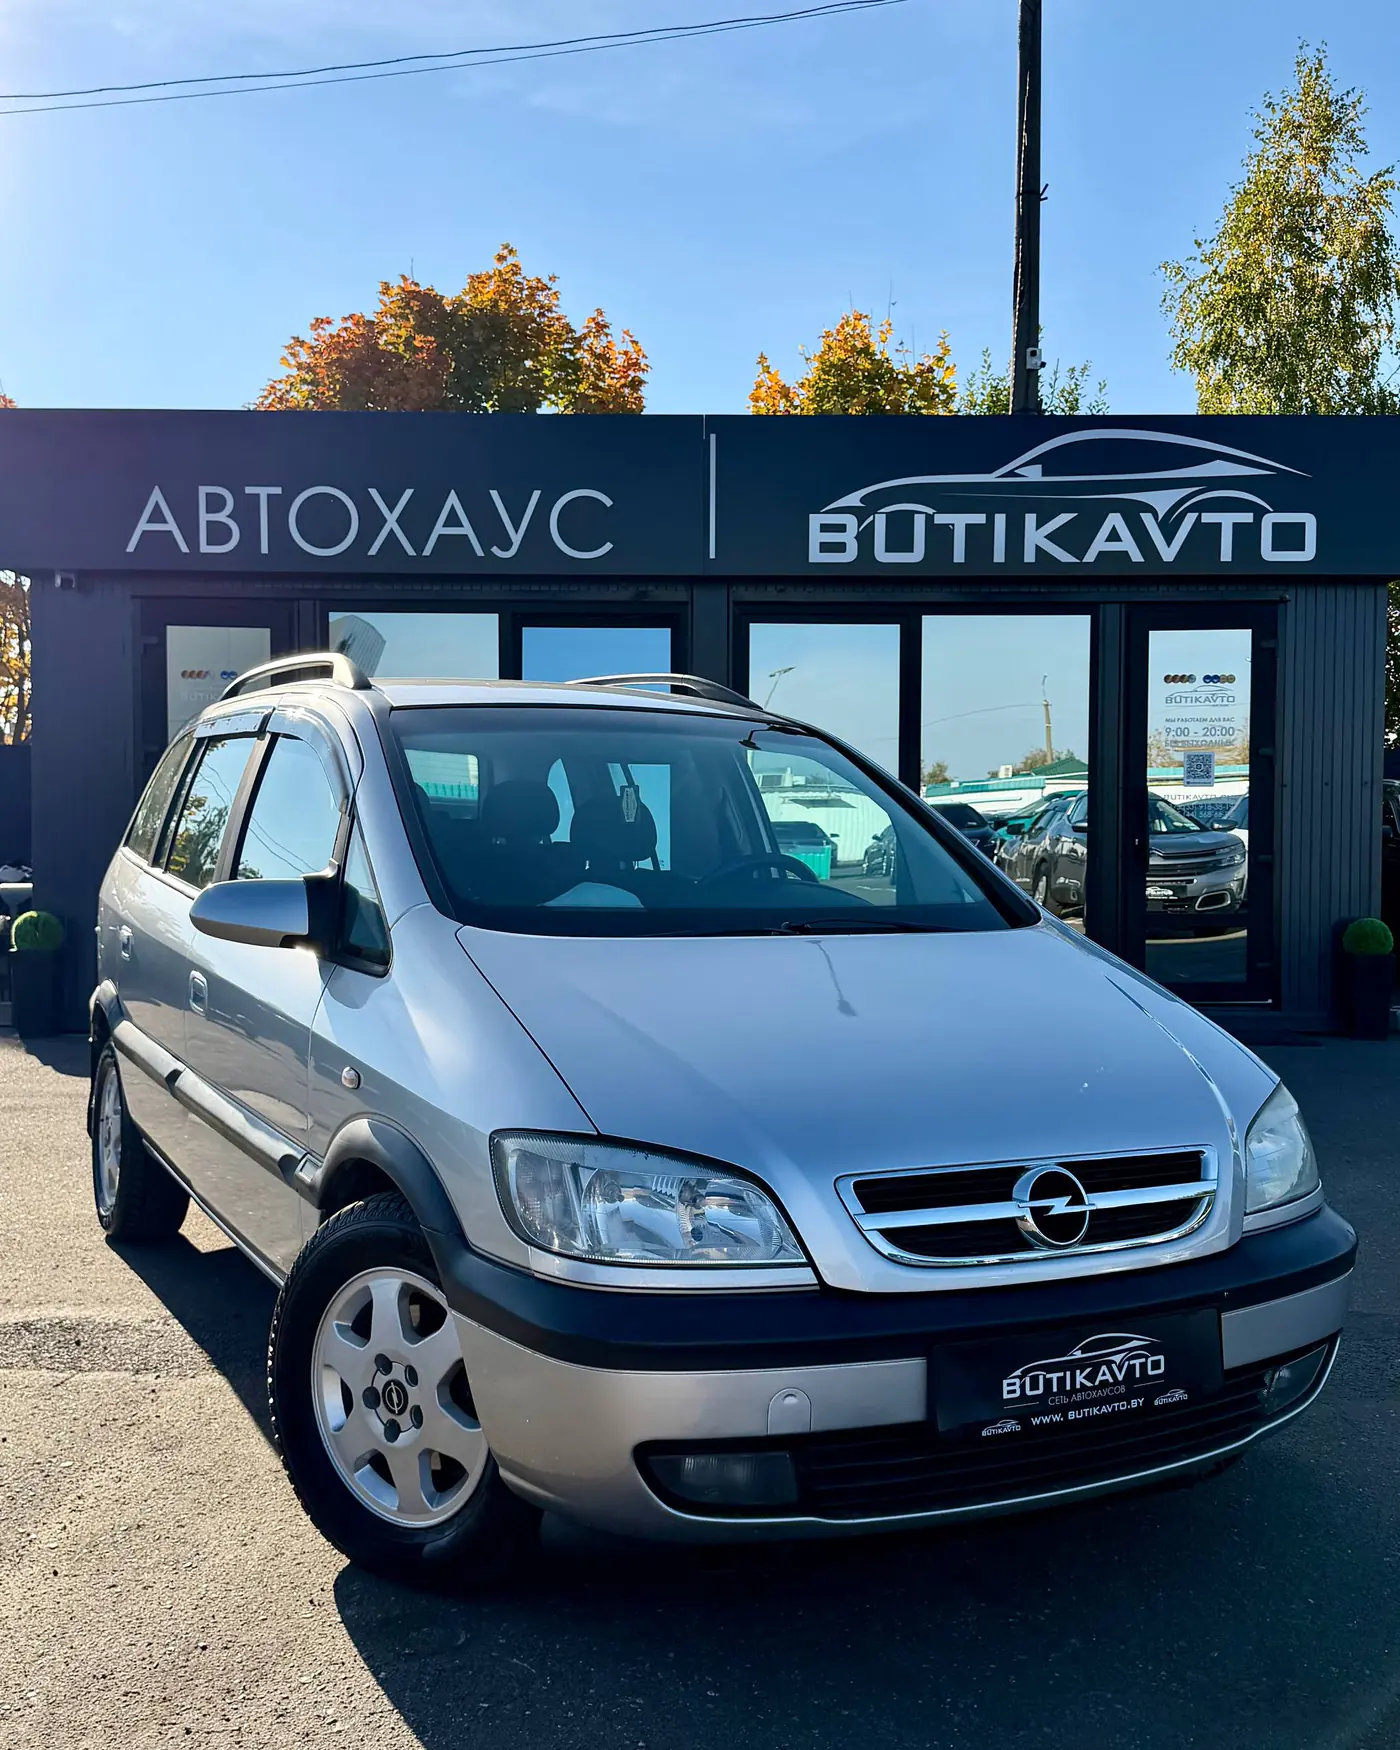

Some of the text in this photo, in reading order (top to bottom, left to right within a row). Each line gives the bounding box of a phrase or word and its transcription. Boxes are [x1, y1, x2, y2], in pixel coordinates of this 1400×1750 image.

[125, 485, 614, 560] АВТОХАУС
[808, 512, 1317, 563] BUTIKAVTO
[1165, 695, 1236, 705] BUTIKAVTO
[1165, 726, 1190, 737] 9:00
[1202, 726, 1236, 737] 20:00
[1002, 1354, 1165, 1400] BUTIKAVTO
[1048, 1385, 1126, 1406] СЕТЬ АВТОХАУСОВ
[1153, 1393, 1188, 1406] BUTIKAVTO
[1031, 1397, 1145, 1426] WWW. BUTIKAVTO.BY
[982, 1425, 1021, 1437] BUTIKAVTO
